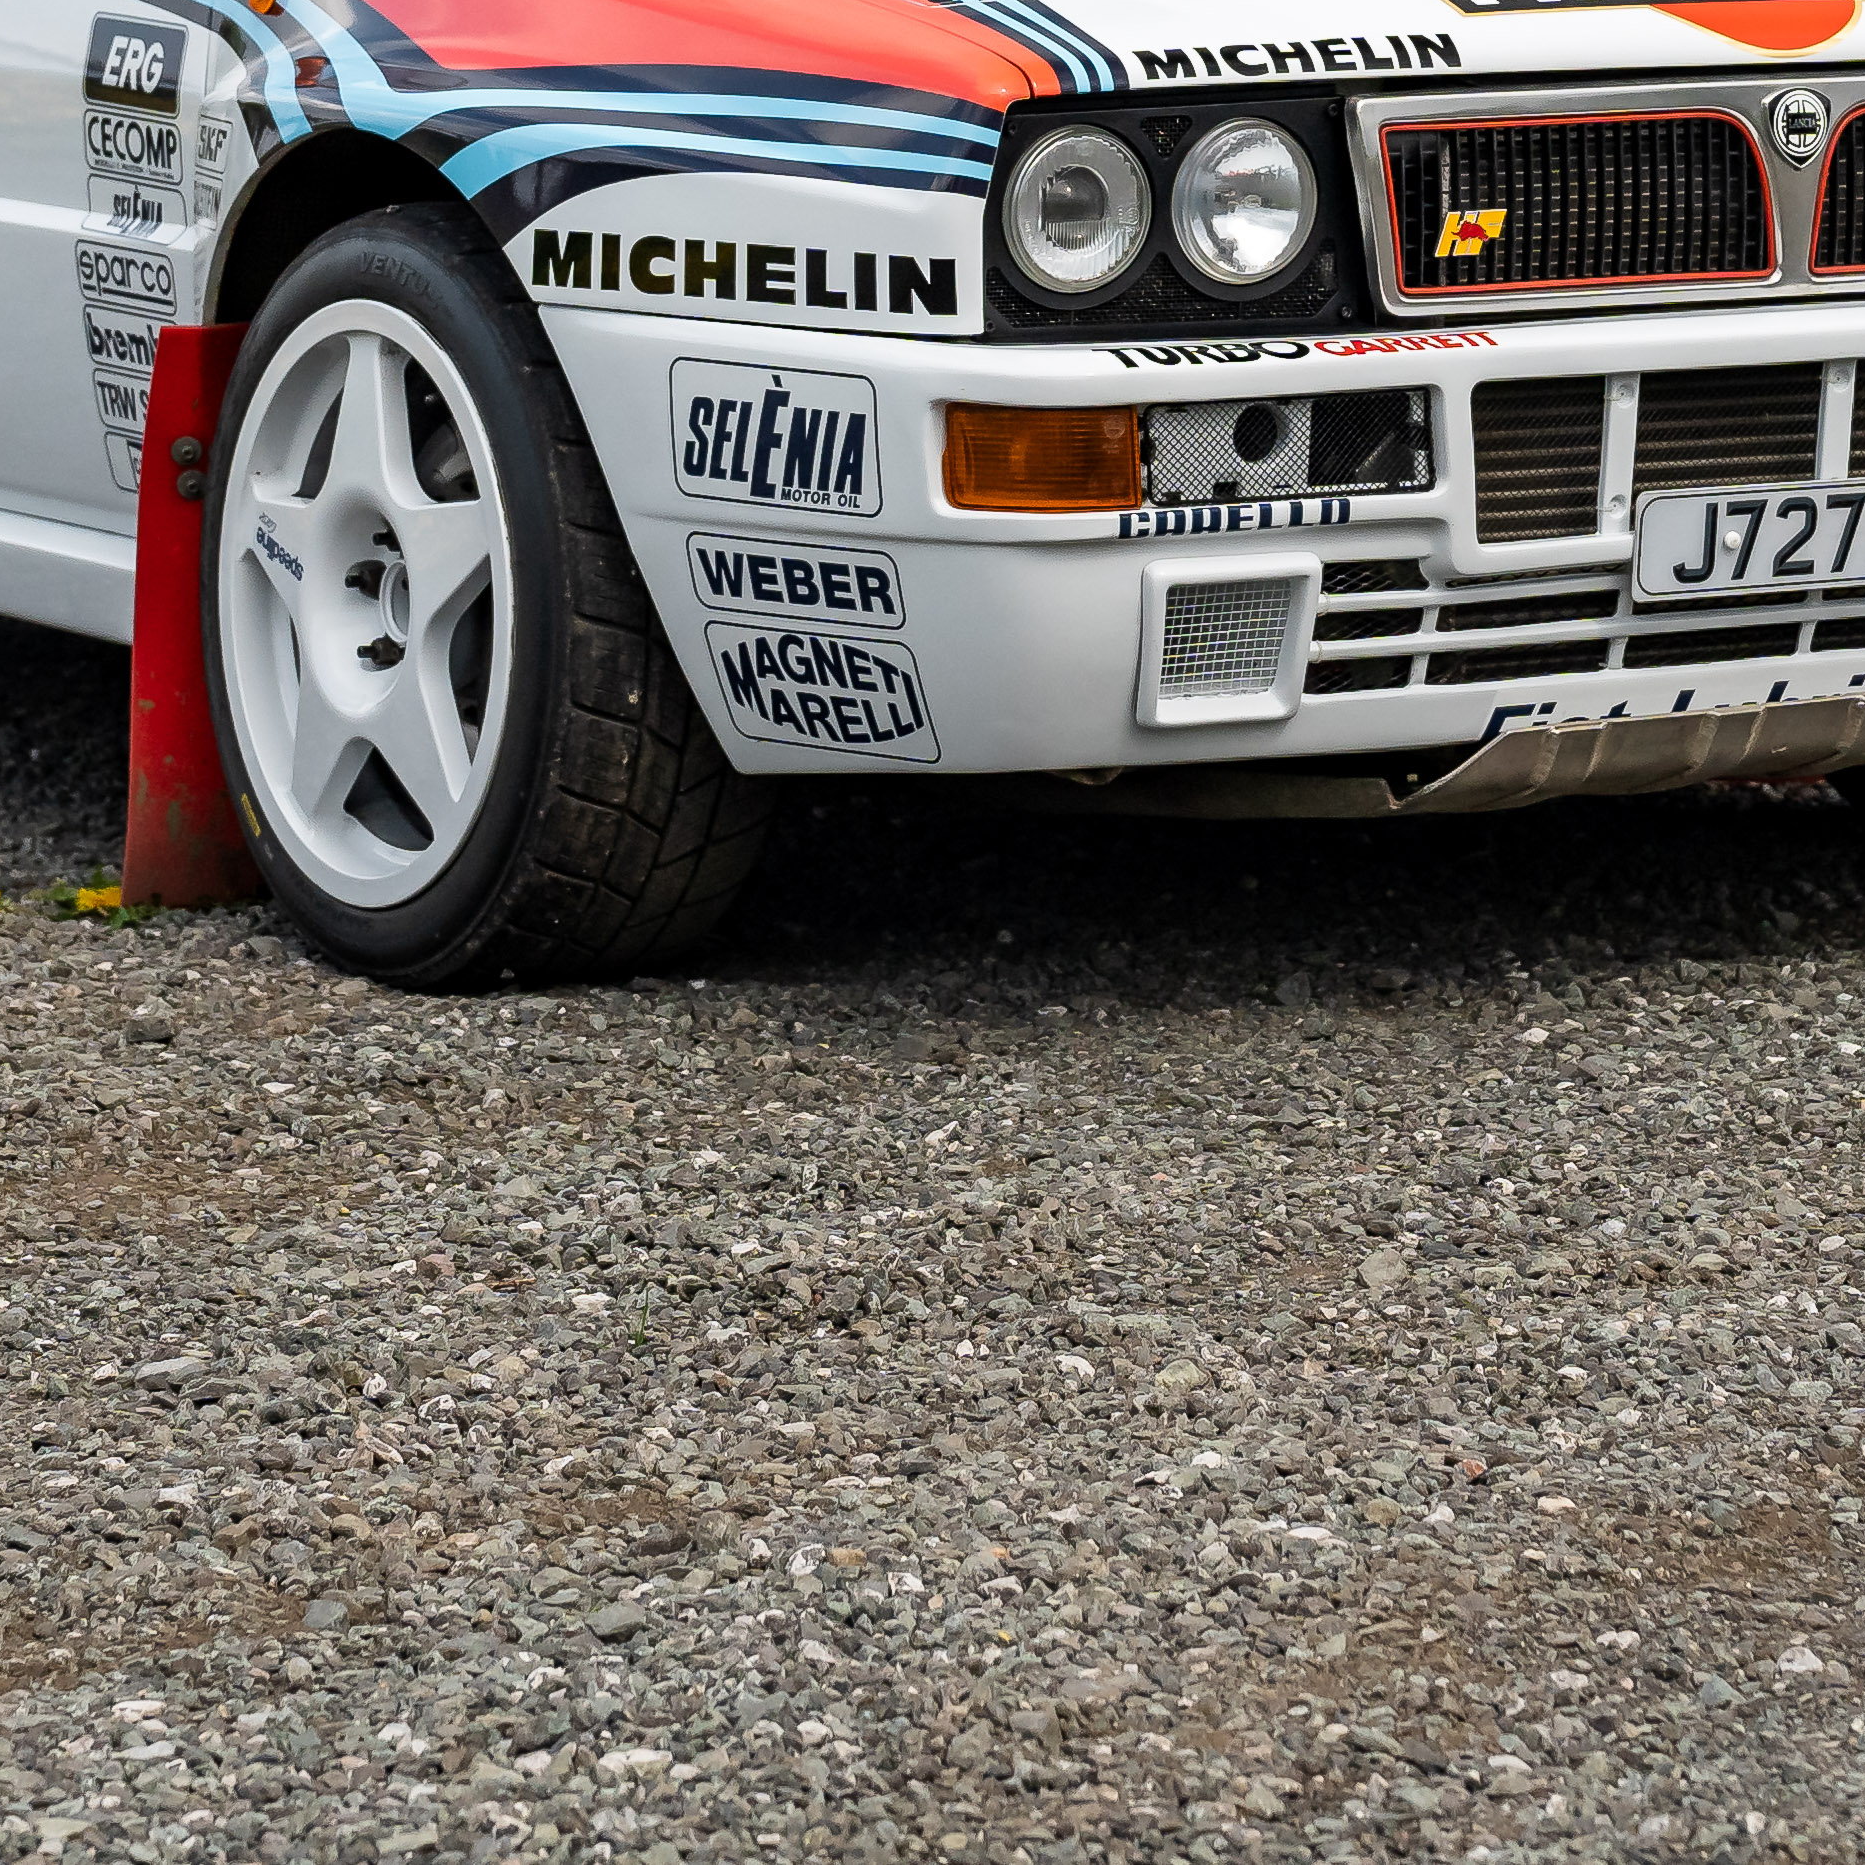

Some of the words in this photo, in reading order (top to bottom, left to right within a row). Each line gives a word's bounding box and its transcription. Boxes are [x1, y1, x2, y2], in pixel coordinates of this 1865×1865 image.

[101, 35, 165, 94] ERG
[1132, 33, 1463, 81] MICHELIN
[87, 116, 178, 170] CECOMP
[79, 249, 172, 296] sparco
[531, 228, 958, 317] MICHELIN
[1091, 340, 1311, 369] TURBO
[1314, 331, 1500, 356] GARRETT
[97, 380, 138, 422] TRW
[683, 373, 867, 500] SELÈNIA
[781, 487, 831, 506] MOTOR
[837, 494, 861, 509] OIL
[696, 547, 897, 615] WEBER
[721, 634, 924, 712] MAGNETI
